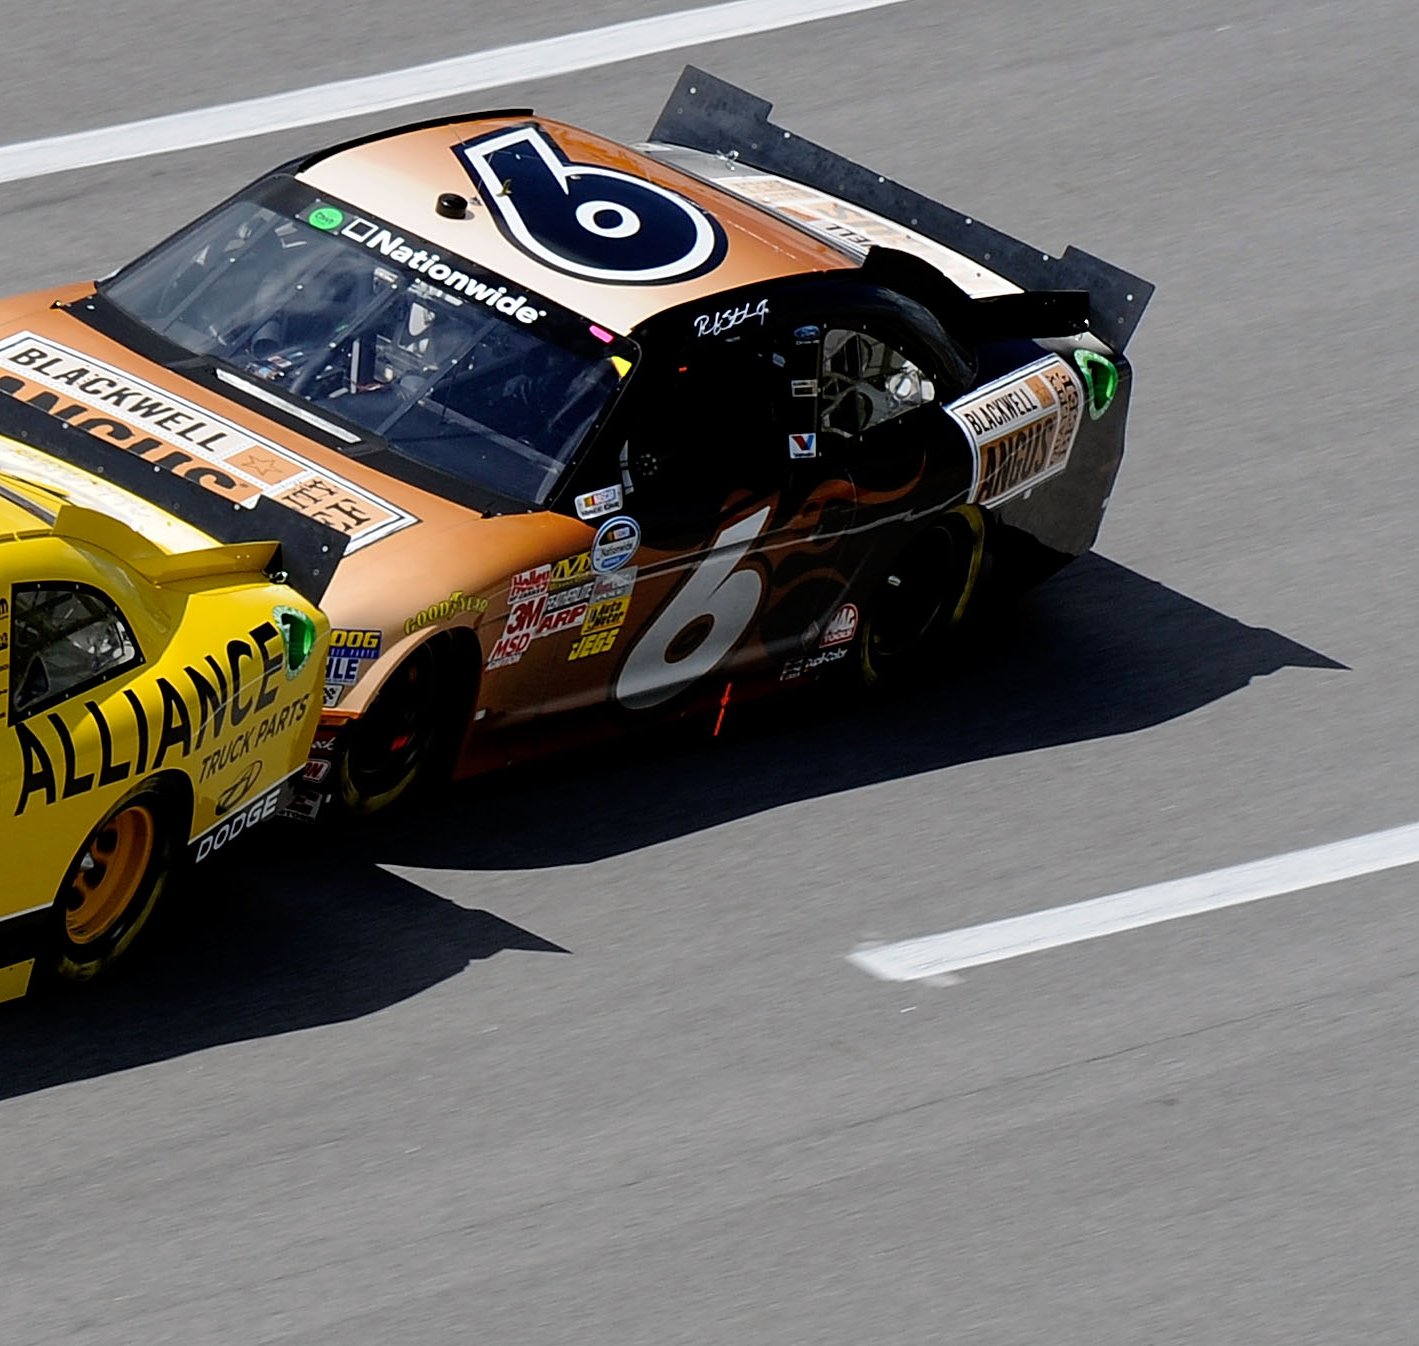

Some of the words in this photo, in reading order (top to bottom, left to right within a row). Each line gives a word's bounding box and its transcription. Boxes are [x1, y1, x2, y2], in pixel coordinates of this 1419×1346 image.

[455, 126, 725, 283] 6
[368, 230, 537, 325] Nationwide
[8, 347, 230, 453] BLACKWELL
[964, 388, 1038, 435] BLACKWELL
[976, 418, 1057, 503] ANGUS
[507, 597, 547, 635] 3M
[513, 570, 550, 588] Holley
[536, 604, 588, 633] ARP
[617, 505, 770, 710] 6
[490, 633, 531, 658] MSD
[569, 628, 620, 660] JEGS
[15, 622, 285, 816] ALLIANCE
[198, 725, 252, 784] TRUCK
[253, 692, 310, 749] PARTS
[195, 788, 282, 864] DODGE
